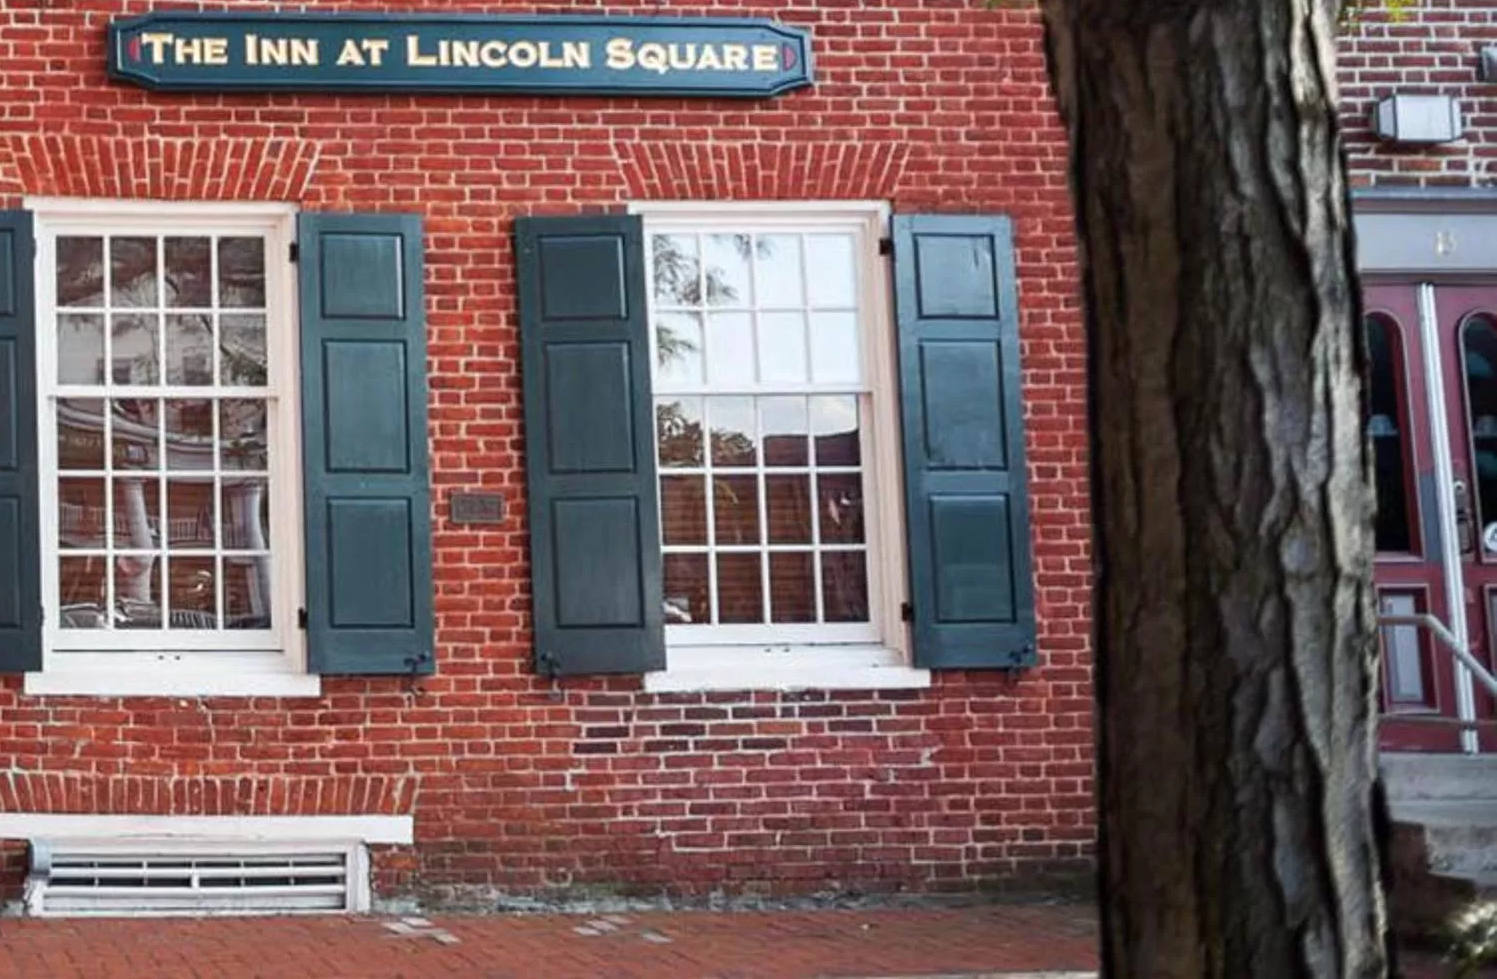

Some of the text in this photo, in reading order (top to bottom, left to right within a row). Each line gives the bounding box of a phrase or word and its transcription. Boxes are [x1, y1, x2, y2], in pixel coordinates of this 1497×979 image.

[140, 32, 780, 75] THE INN AT LINCOLN SQUARE
